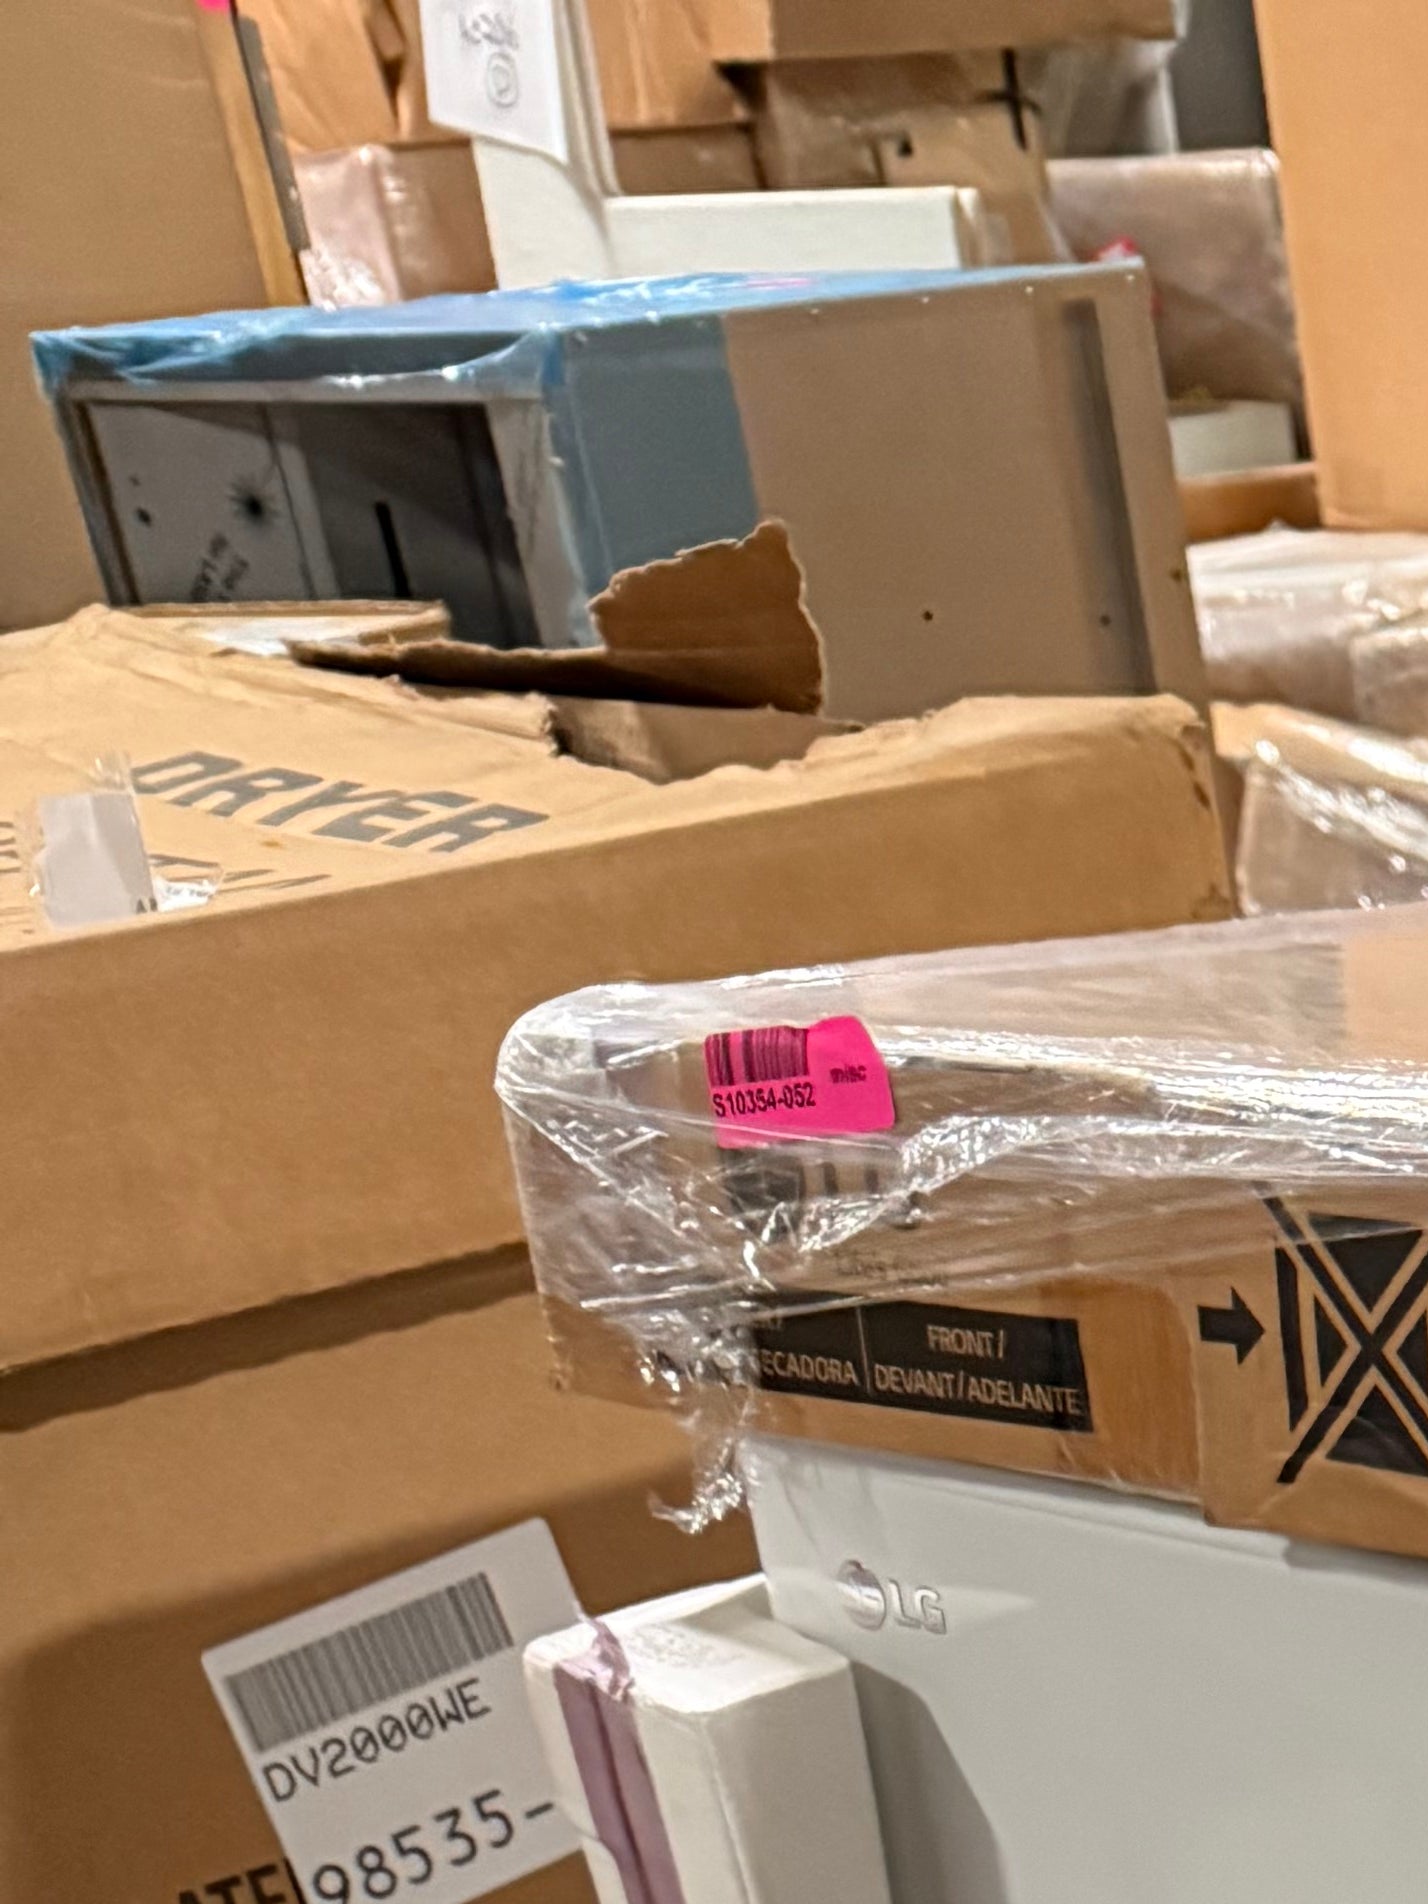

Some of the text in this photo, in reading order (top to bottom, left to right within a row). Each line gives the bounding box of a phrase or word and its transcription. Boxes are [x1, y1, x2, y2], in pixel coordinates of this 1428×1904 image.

[131, 751, 550, 854] DRYER
[757, 1349, 860, 1387] ECADORA
[887, 1577, 948, 1636] LG
[261, 1676, 492, 1803] DV2000WE
